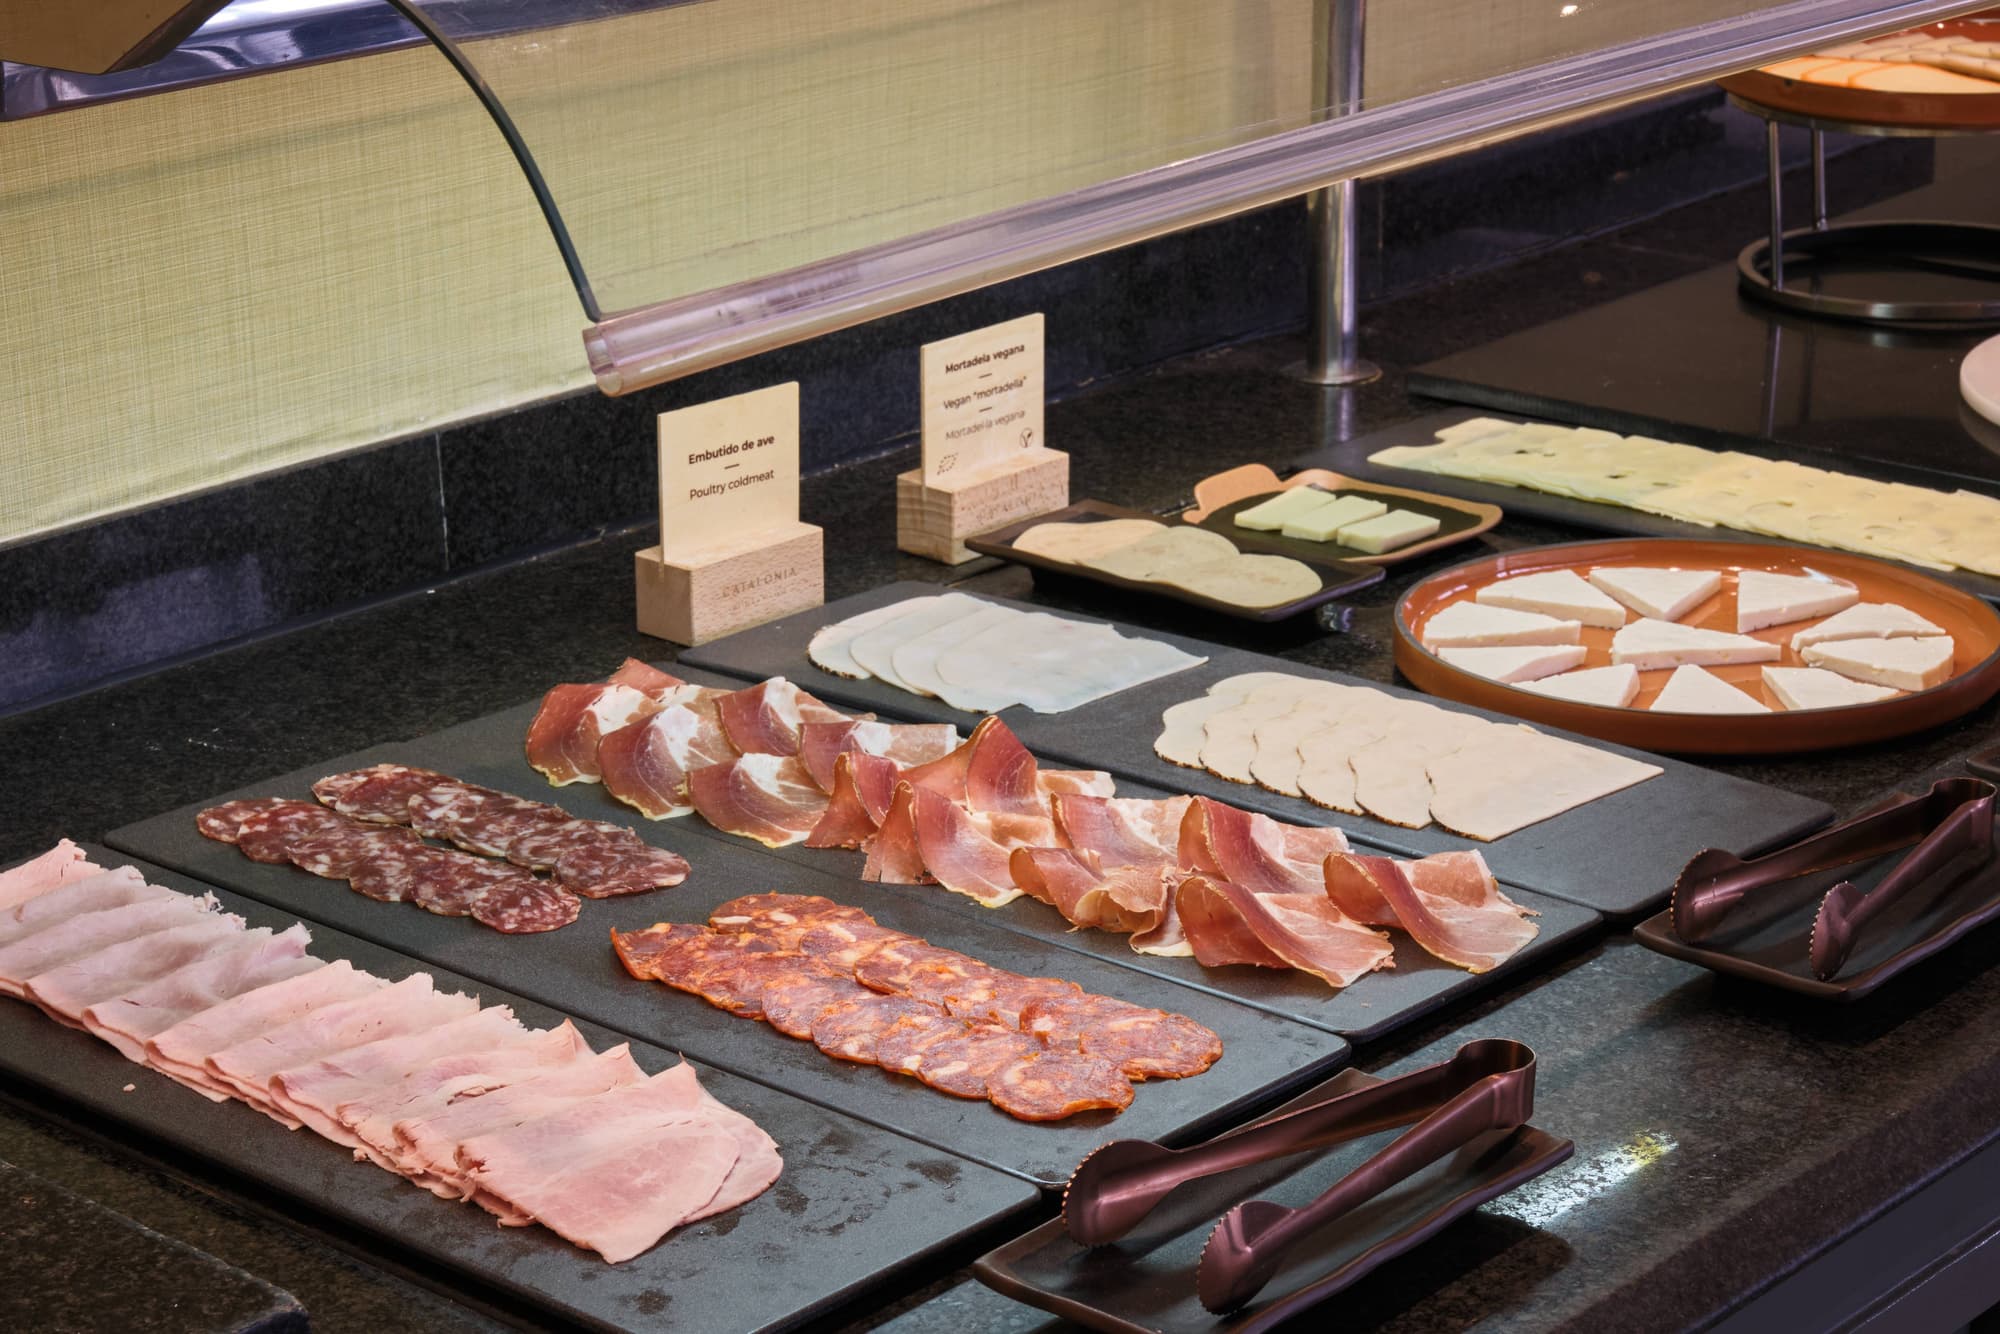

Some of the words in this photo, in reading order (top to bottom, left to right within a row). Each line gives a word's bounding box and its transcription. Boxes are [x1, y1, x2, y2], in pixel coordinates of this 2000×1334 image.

[945, 353, 990, 374] Mortadela
[993, 344, 1025, 360] vegana
[943, 395, 971, 409] Vegan
[995, 410, 1025, 426] vegana
[688, 443, 739, 464] Embutido
[741, 440, 754, 451] de
[757, 435, 775, 447] ave
[689, 482, 726, 500] Poultry
[728, 469, 774, 490] coldmeat
